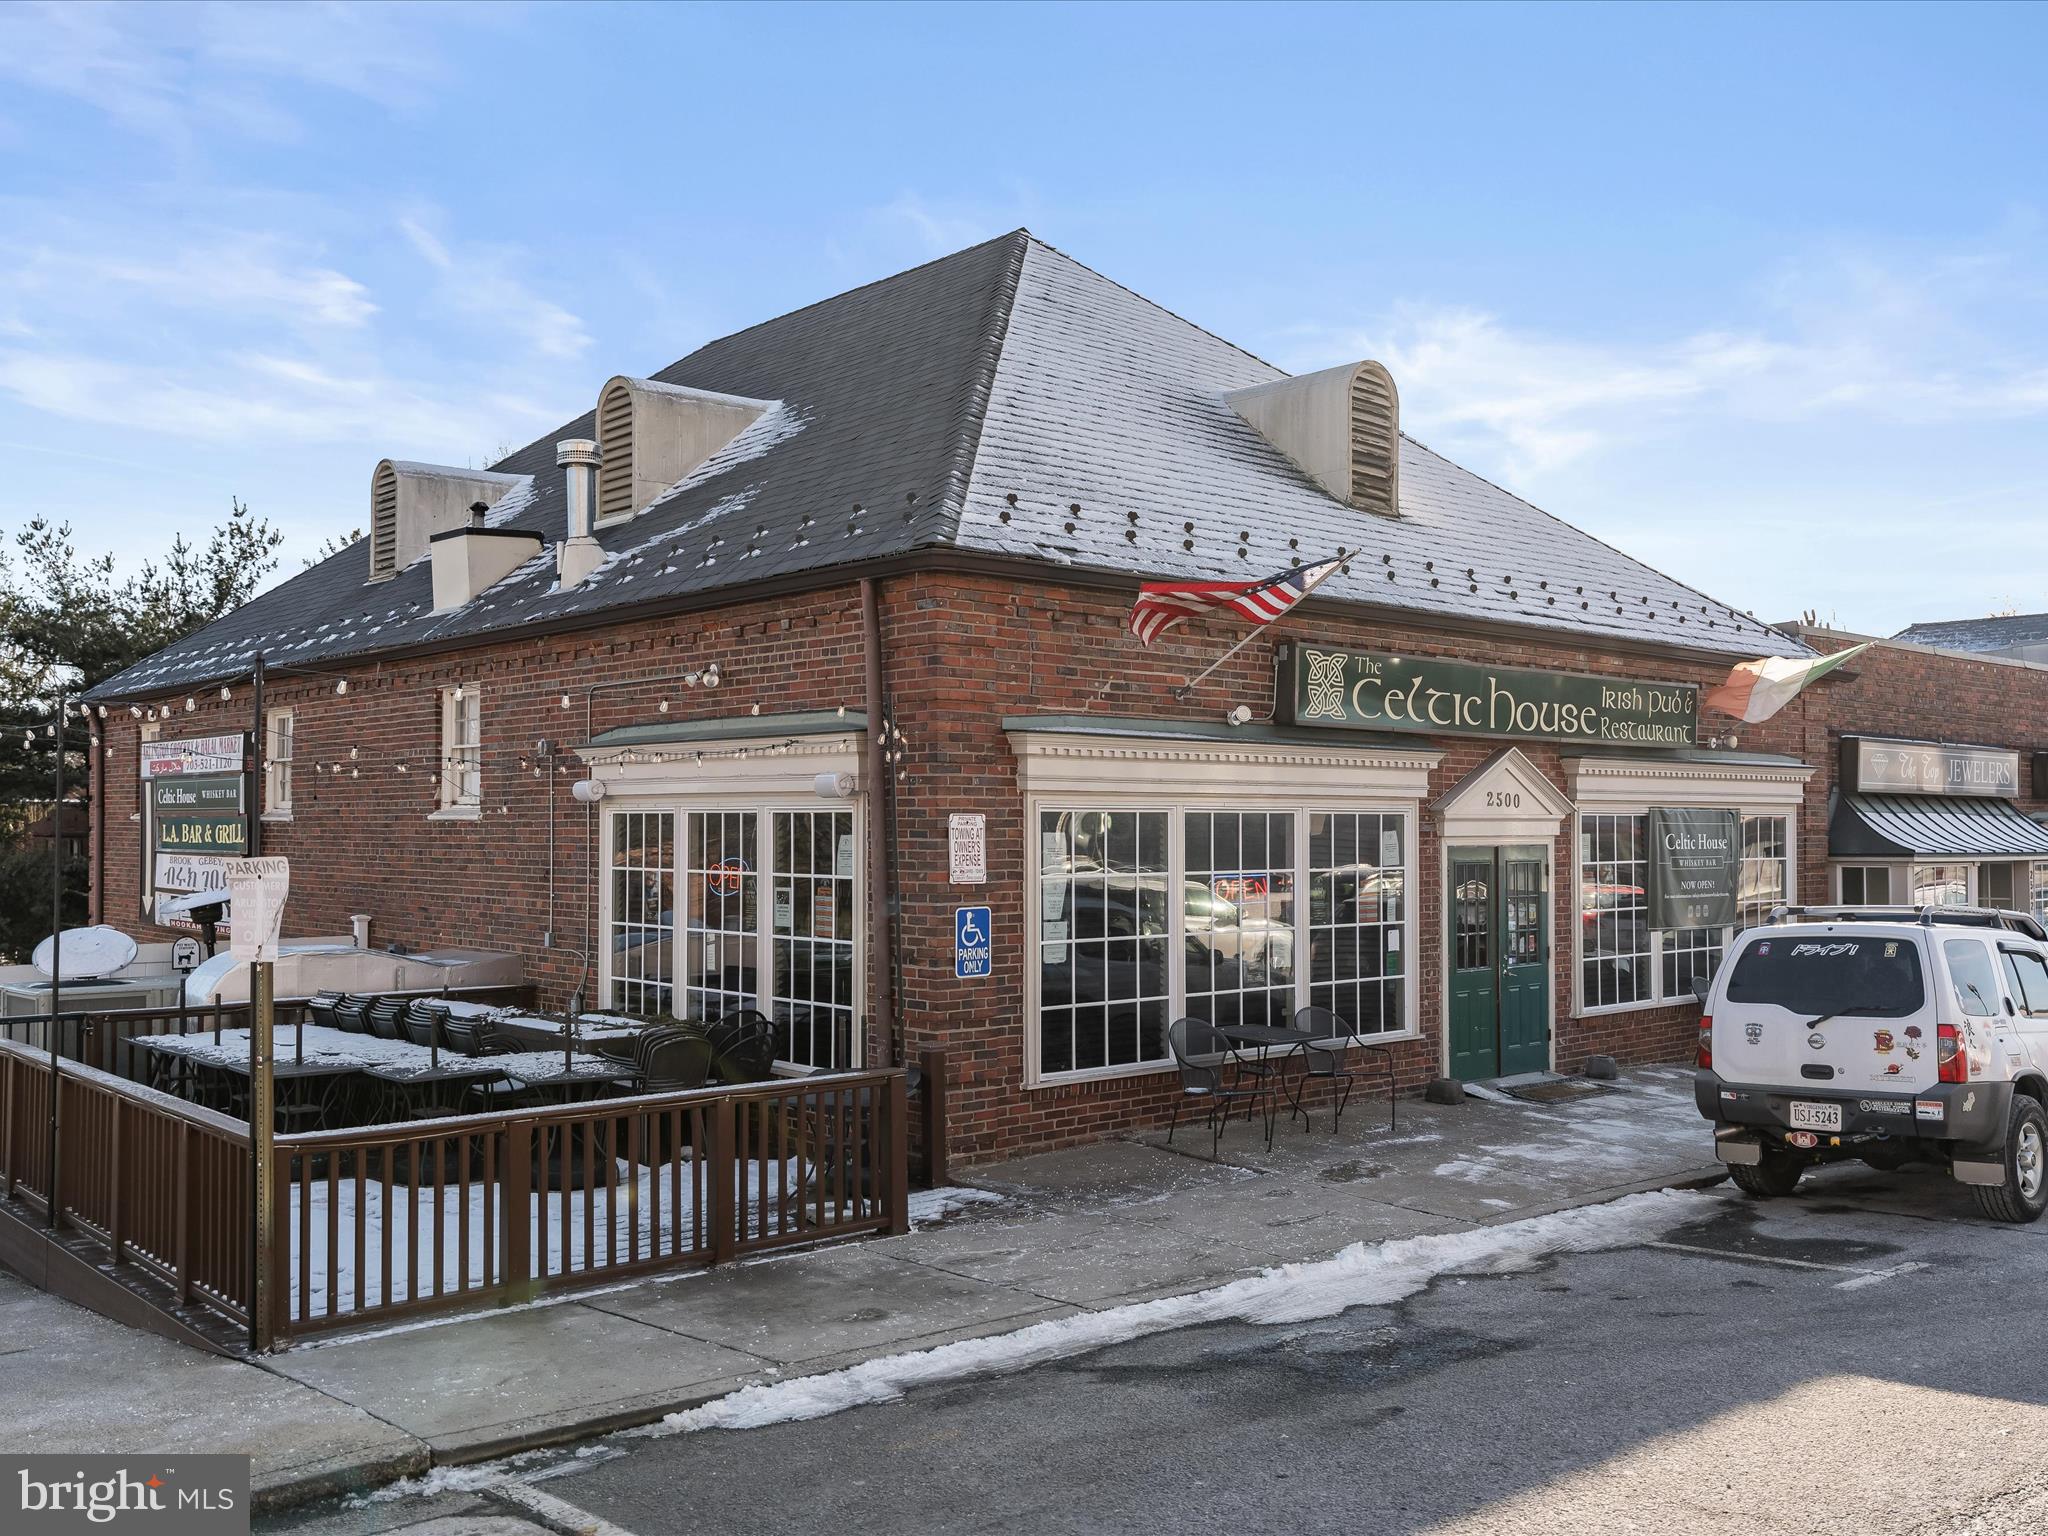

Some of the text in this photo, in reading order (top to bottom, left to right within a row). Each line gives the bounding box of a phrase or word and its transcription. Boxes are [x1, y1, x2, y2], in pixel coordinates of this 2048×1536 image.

[1356, 657, 1382, 675] The
[1352, 675, 1482, 726] Celtic
[1648, 689, 1682, 719] Pub
[1684, 691, 1693, 714] &
[1600, 716, 1693, 744] Restaurant
[1898, 752, 1917, 779] The
[1947, 759, 2010, 785] JEWELERS
[158, 788, 237, 804] Celtic House WHISKEY BAR
[1486, 791, 1521, 809] 2500
[162, 823, 244, 844] L.A. BAR & GRILL
[951, 827, 983, 840] TOWING AT
[953, 840, 981, 853] OWNER'S
[1665, 833, 1728, 850] Celtic House
[169, 856, 192, 865] BROOK
[226, 860, 287, 875] PARKING
[954, 853, 981, 867] EXPENSE
[1679, 858, 1717, 867] WHISKEY BAR
[1680, 879, 1715, 890] NOW OPEN!
[170, 920, 202, 930] HOOKAH
[958, 946, 989, 961] PARKING
[963, 960, 984, 974] ONLY
[1794, 1109, 1839, 1124] USJ-5243
